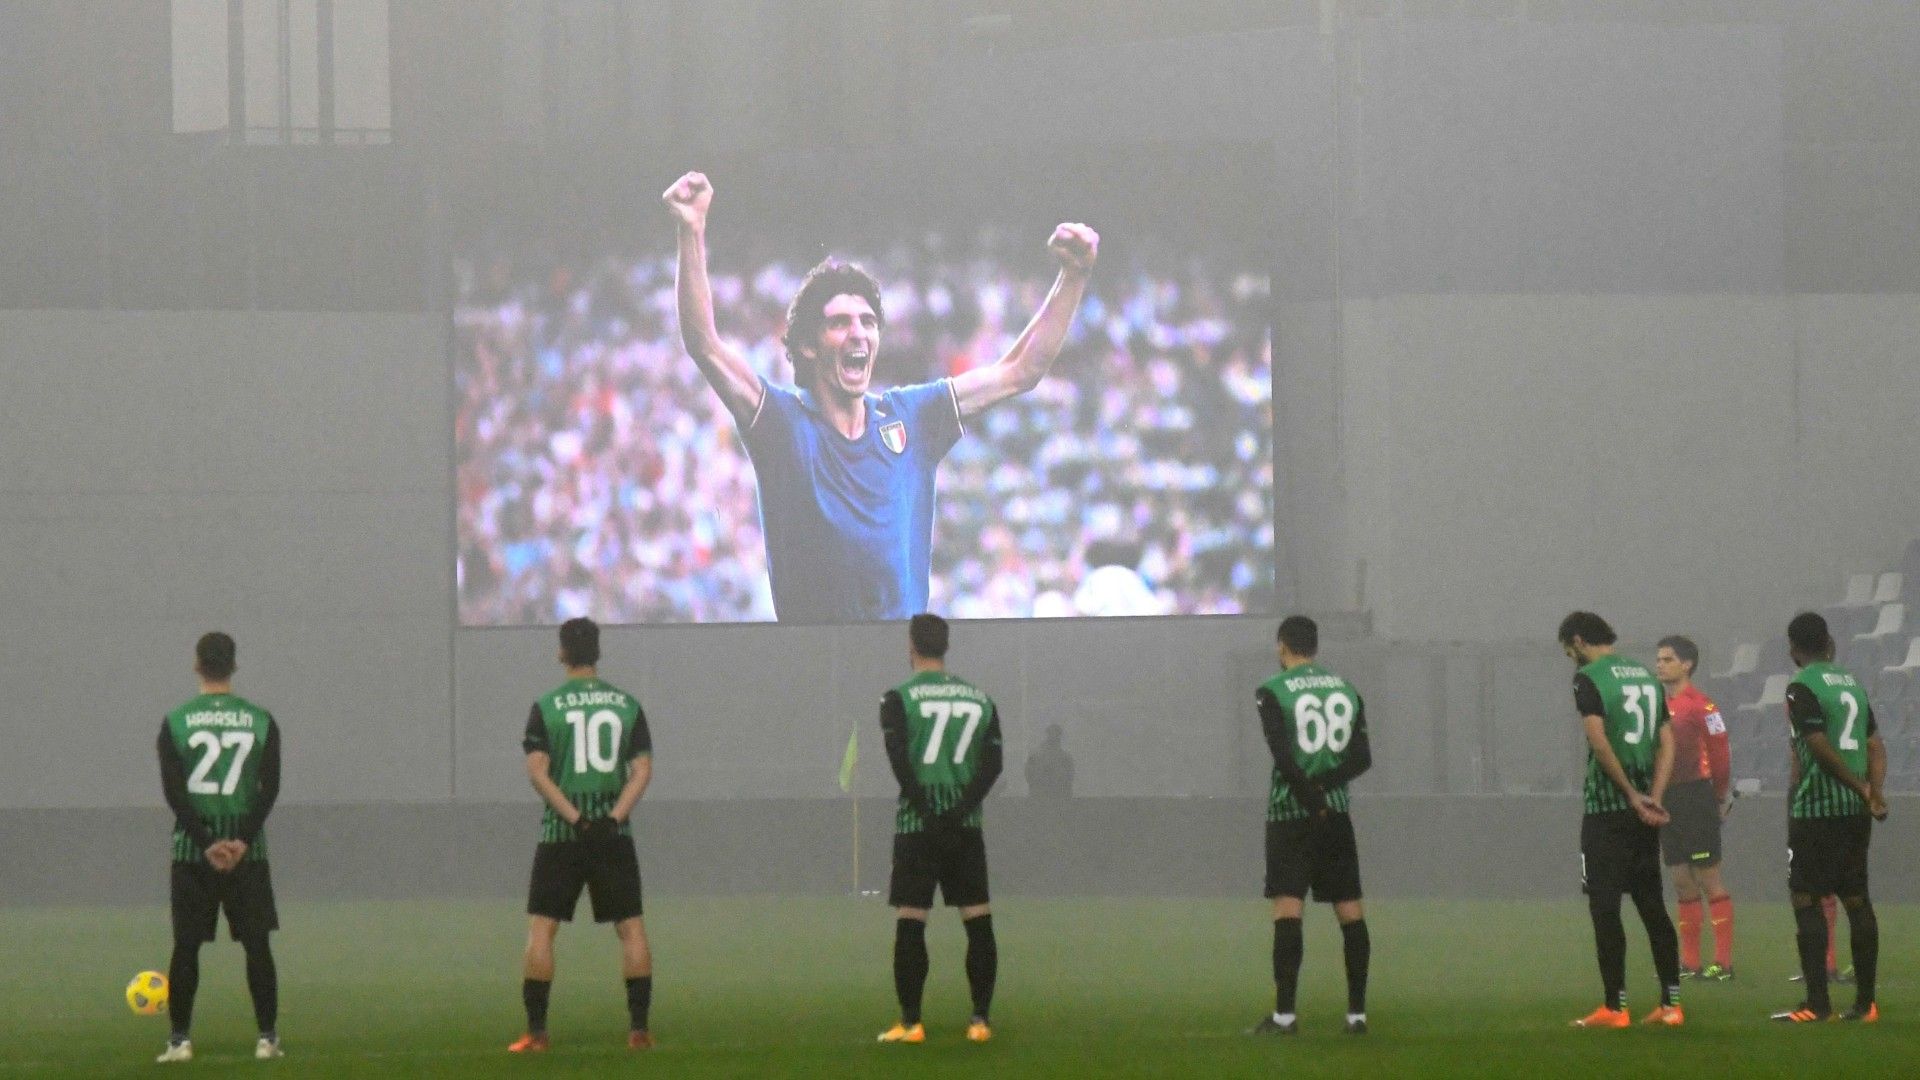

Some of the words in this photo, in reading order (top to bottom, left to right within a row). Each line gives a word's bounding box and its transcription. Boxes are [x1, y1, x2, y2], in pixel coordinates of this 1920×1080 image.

[565, 709, 622, 773] 10
[921, 701, 983, 764] 77
[1295, 692, 1353, 753] 68
[1622, 684, 1657, 744] 31
[1839, 691, 1859, 751] 2
[188, 730, 255, 795] 27
